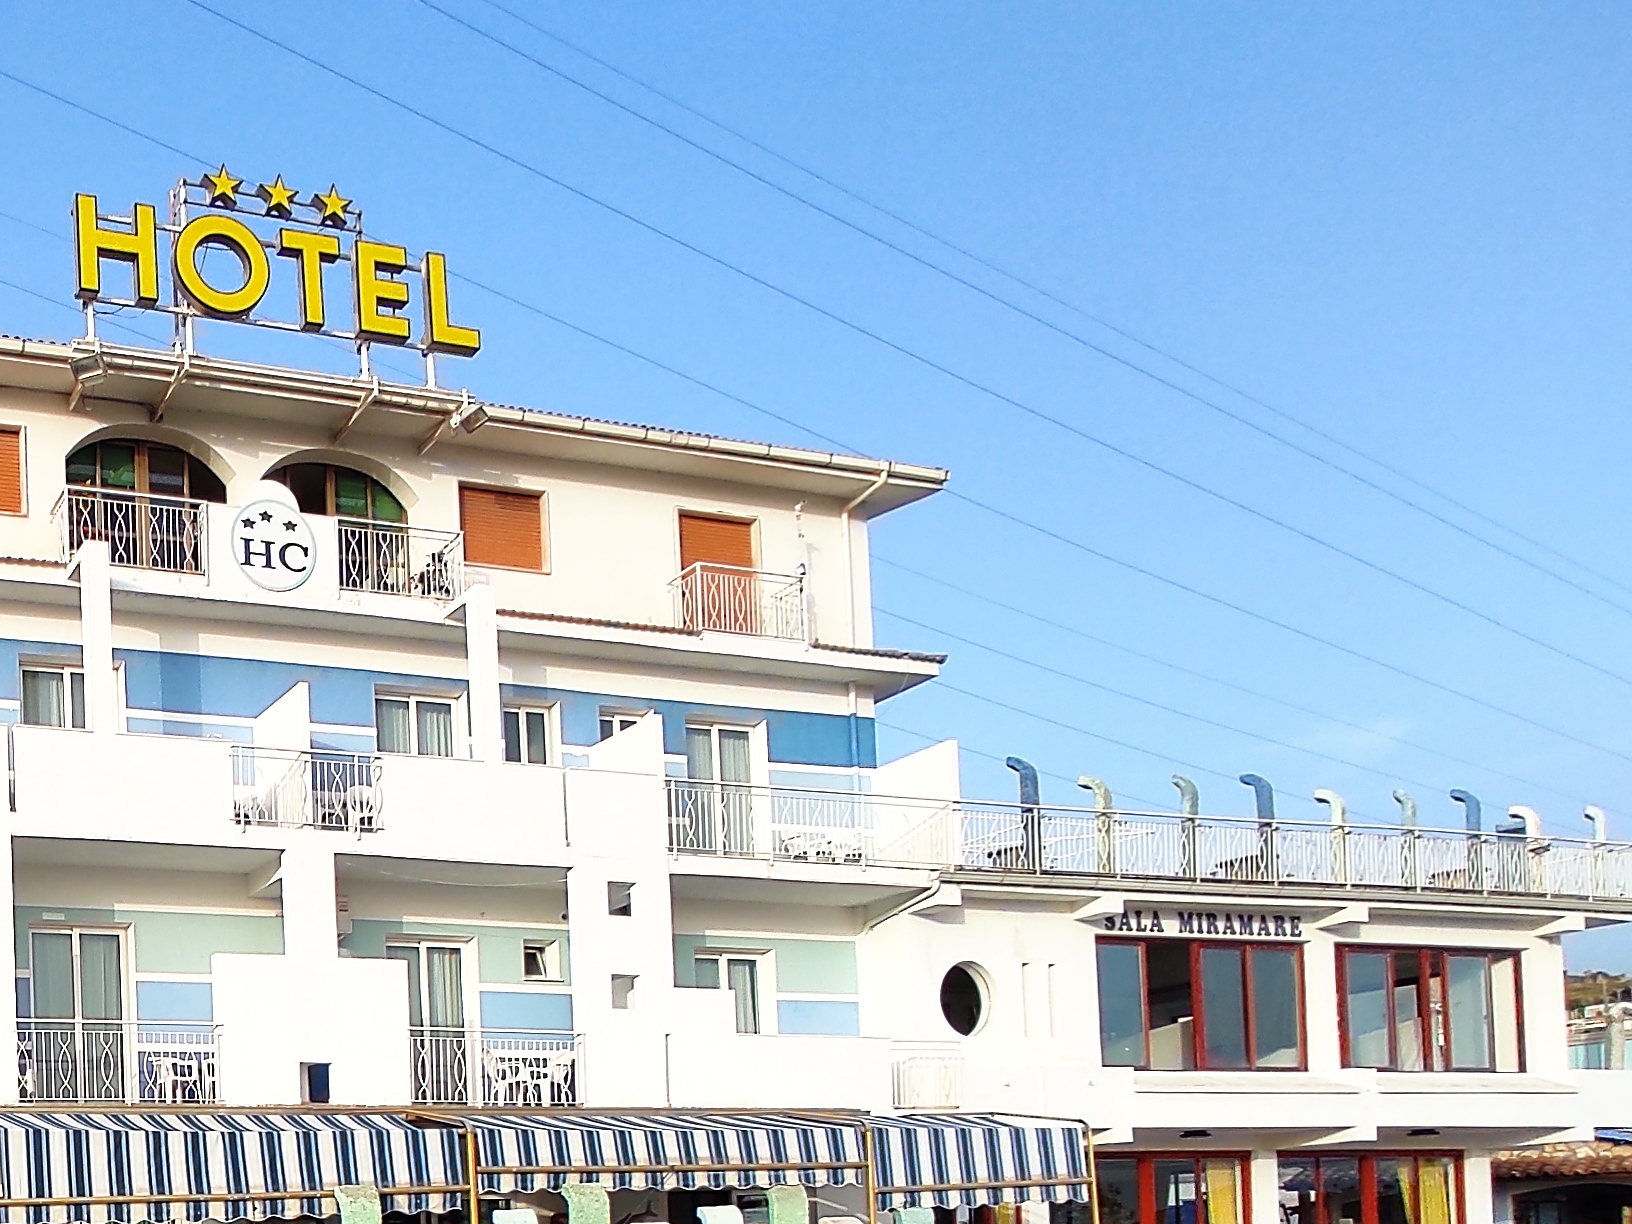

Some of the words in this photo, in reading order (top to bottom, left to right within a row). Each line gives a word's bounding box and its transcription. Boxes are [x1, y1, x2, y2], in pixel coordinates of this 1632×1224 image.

[74, 193, 481, 357] HOTEL
[239, 536, 309, 573] HC
[1103, 909, 1165, 933] SALA
[1177, 911, 1303, 938] MIRAMARE
